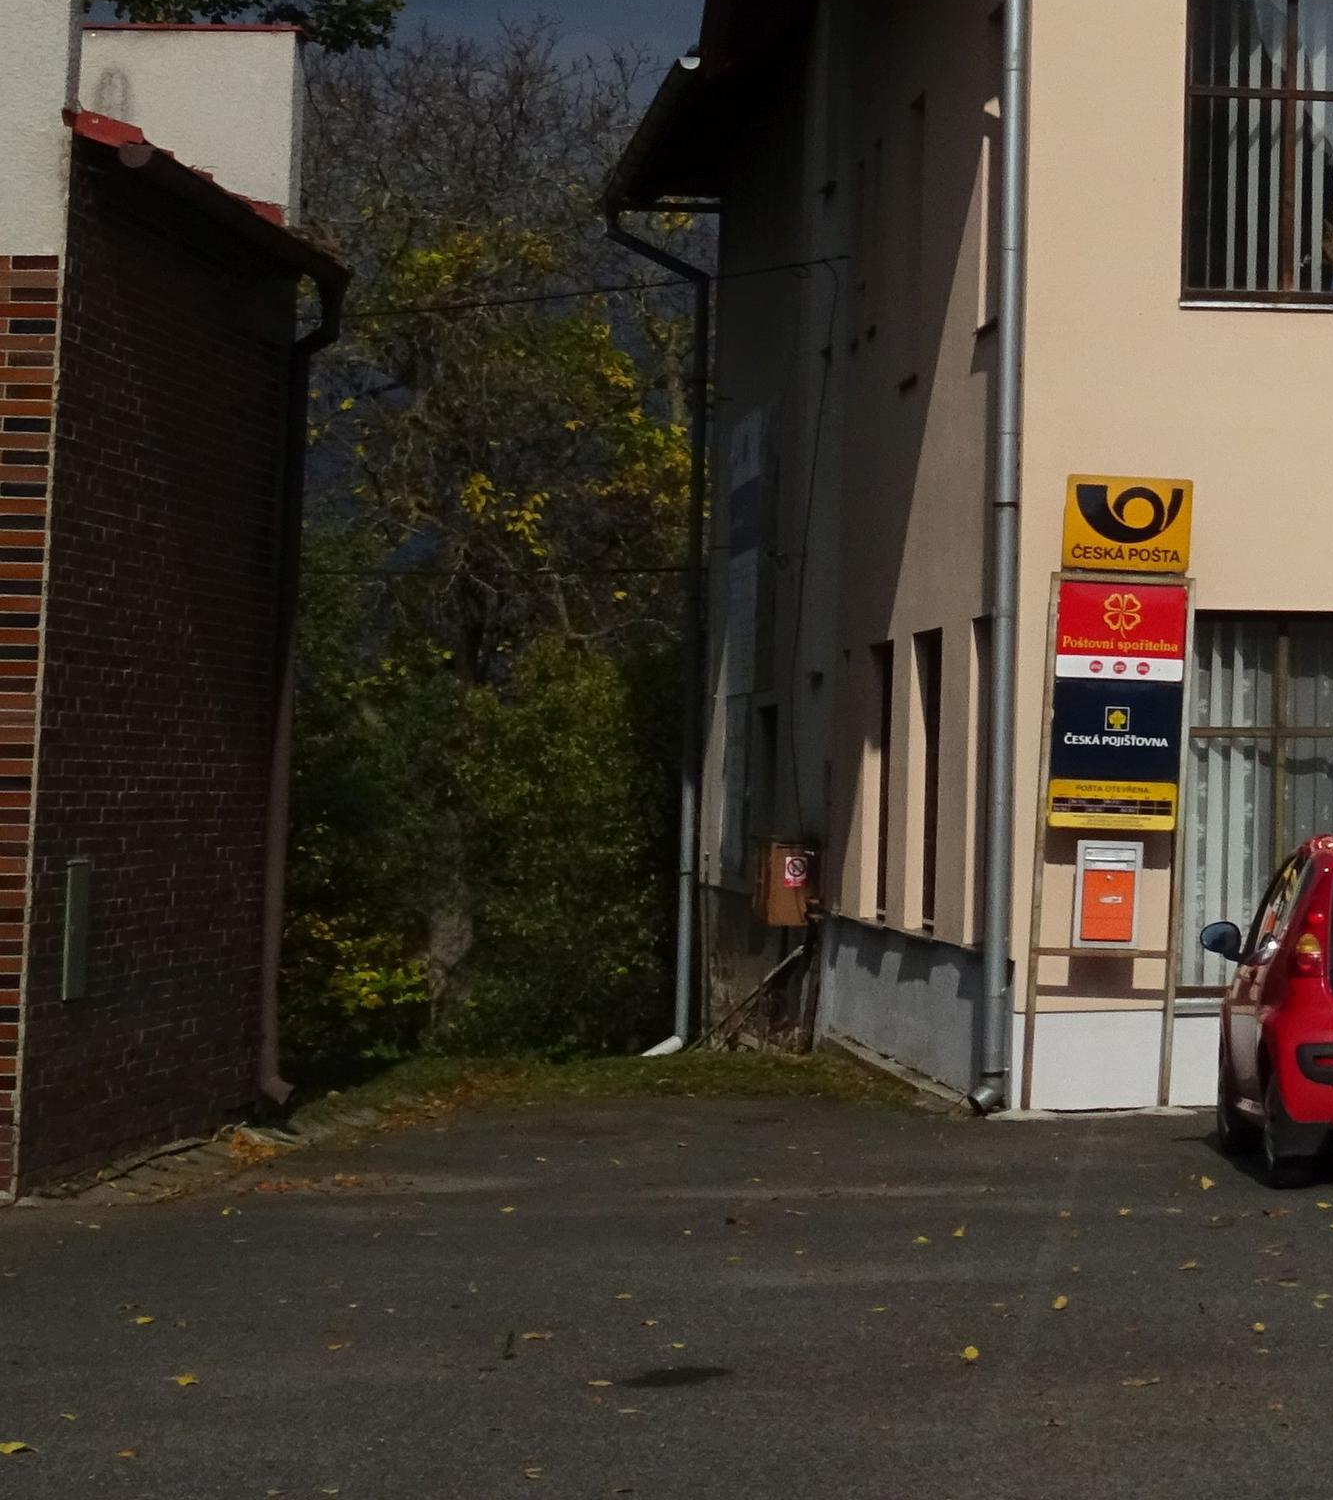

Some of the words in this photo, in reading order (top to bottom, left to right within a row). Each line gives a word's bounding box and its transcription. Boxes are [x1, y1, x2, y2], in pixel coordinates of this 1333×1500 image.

[1072, 543, 1125, 560] ČESKÁ
[1128, 546, 1182, 564] POŠTA
[1062, 635, 1114, 649] Poštovní
[1118, 638, 1179, 654] spořitelna
[1064, 732, 1100, 746] ČESKÁ
[1102, 734, 1169, 748] POJIŠŤOVNA
